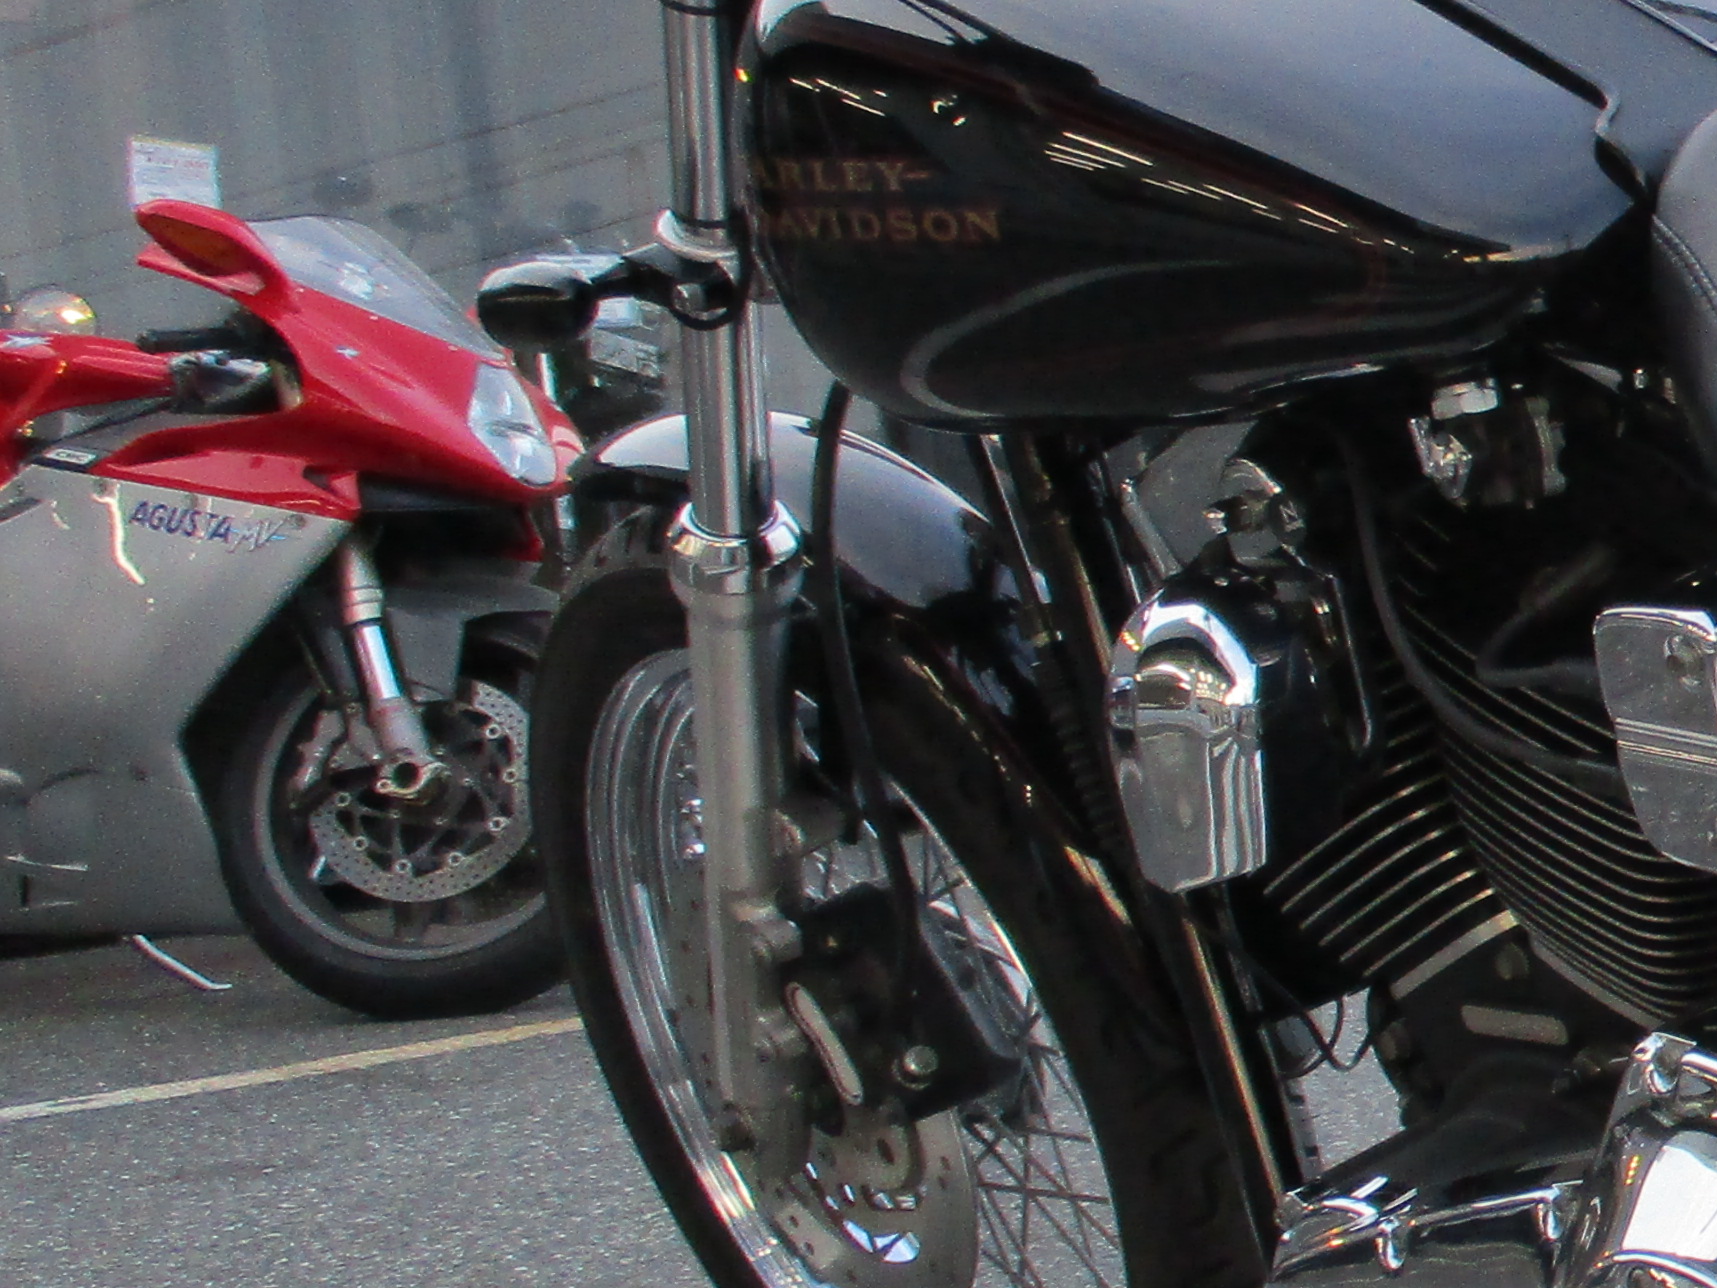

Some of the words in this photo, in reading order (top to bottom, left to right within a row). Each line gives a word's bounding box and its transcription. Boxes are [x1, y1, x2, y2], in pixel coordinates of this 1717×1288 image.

[756, 157, 931, 192] ARLEY-
[764, 205, 1004, 244] AVIDSON
[129, 500, 232, 544] AGUSTA
